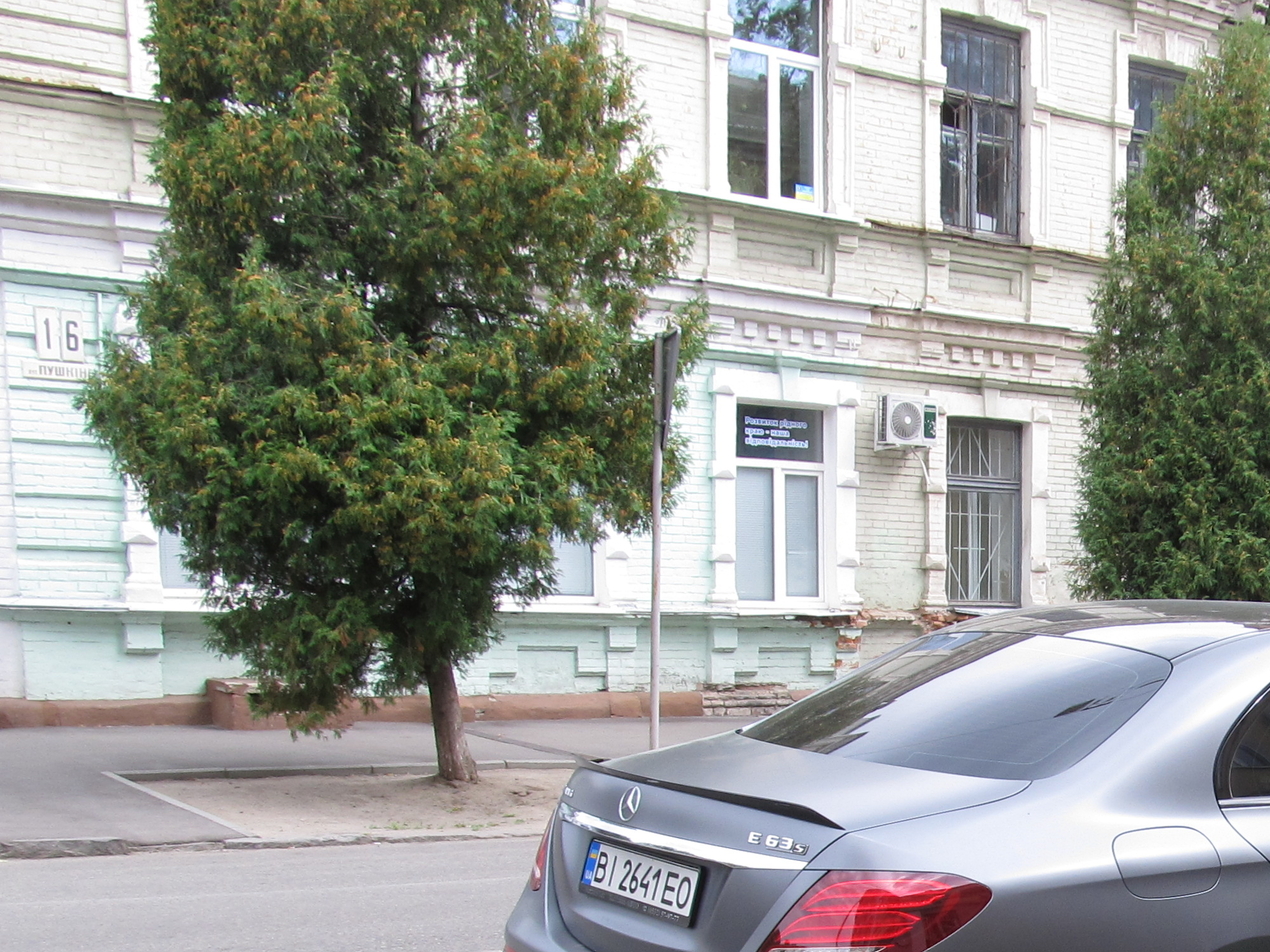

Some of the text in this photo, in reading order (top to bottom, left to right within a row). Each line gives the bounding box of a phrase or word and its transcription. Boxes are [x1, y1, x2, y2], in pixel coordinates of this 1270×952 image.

[44, 318, 79, 351] 16
[748, 831, 762, 845] E
[593, 852, 617, 886] BI
[618, 859, 662, 901] 2641
